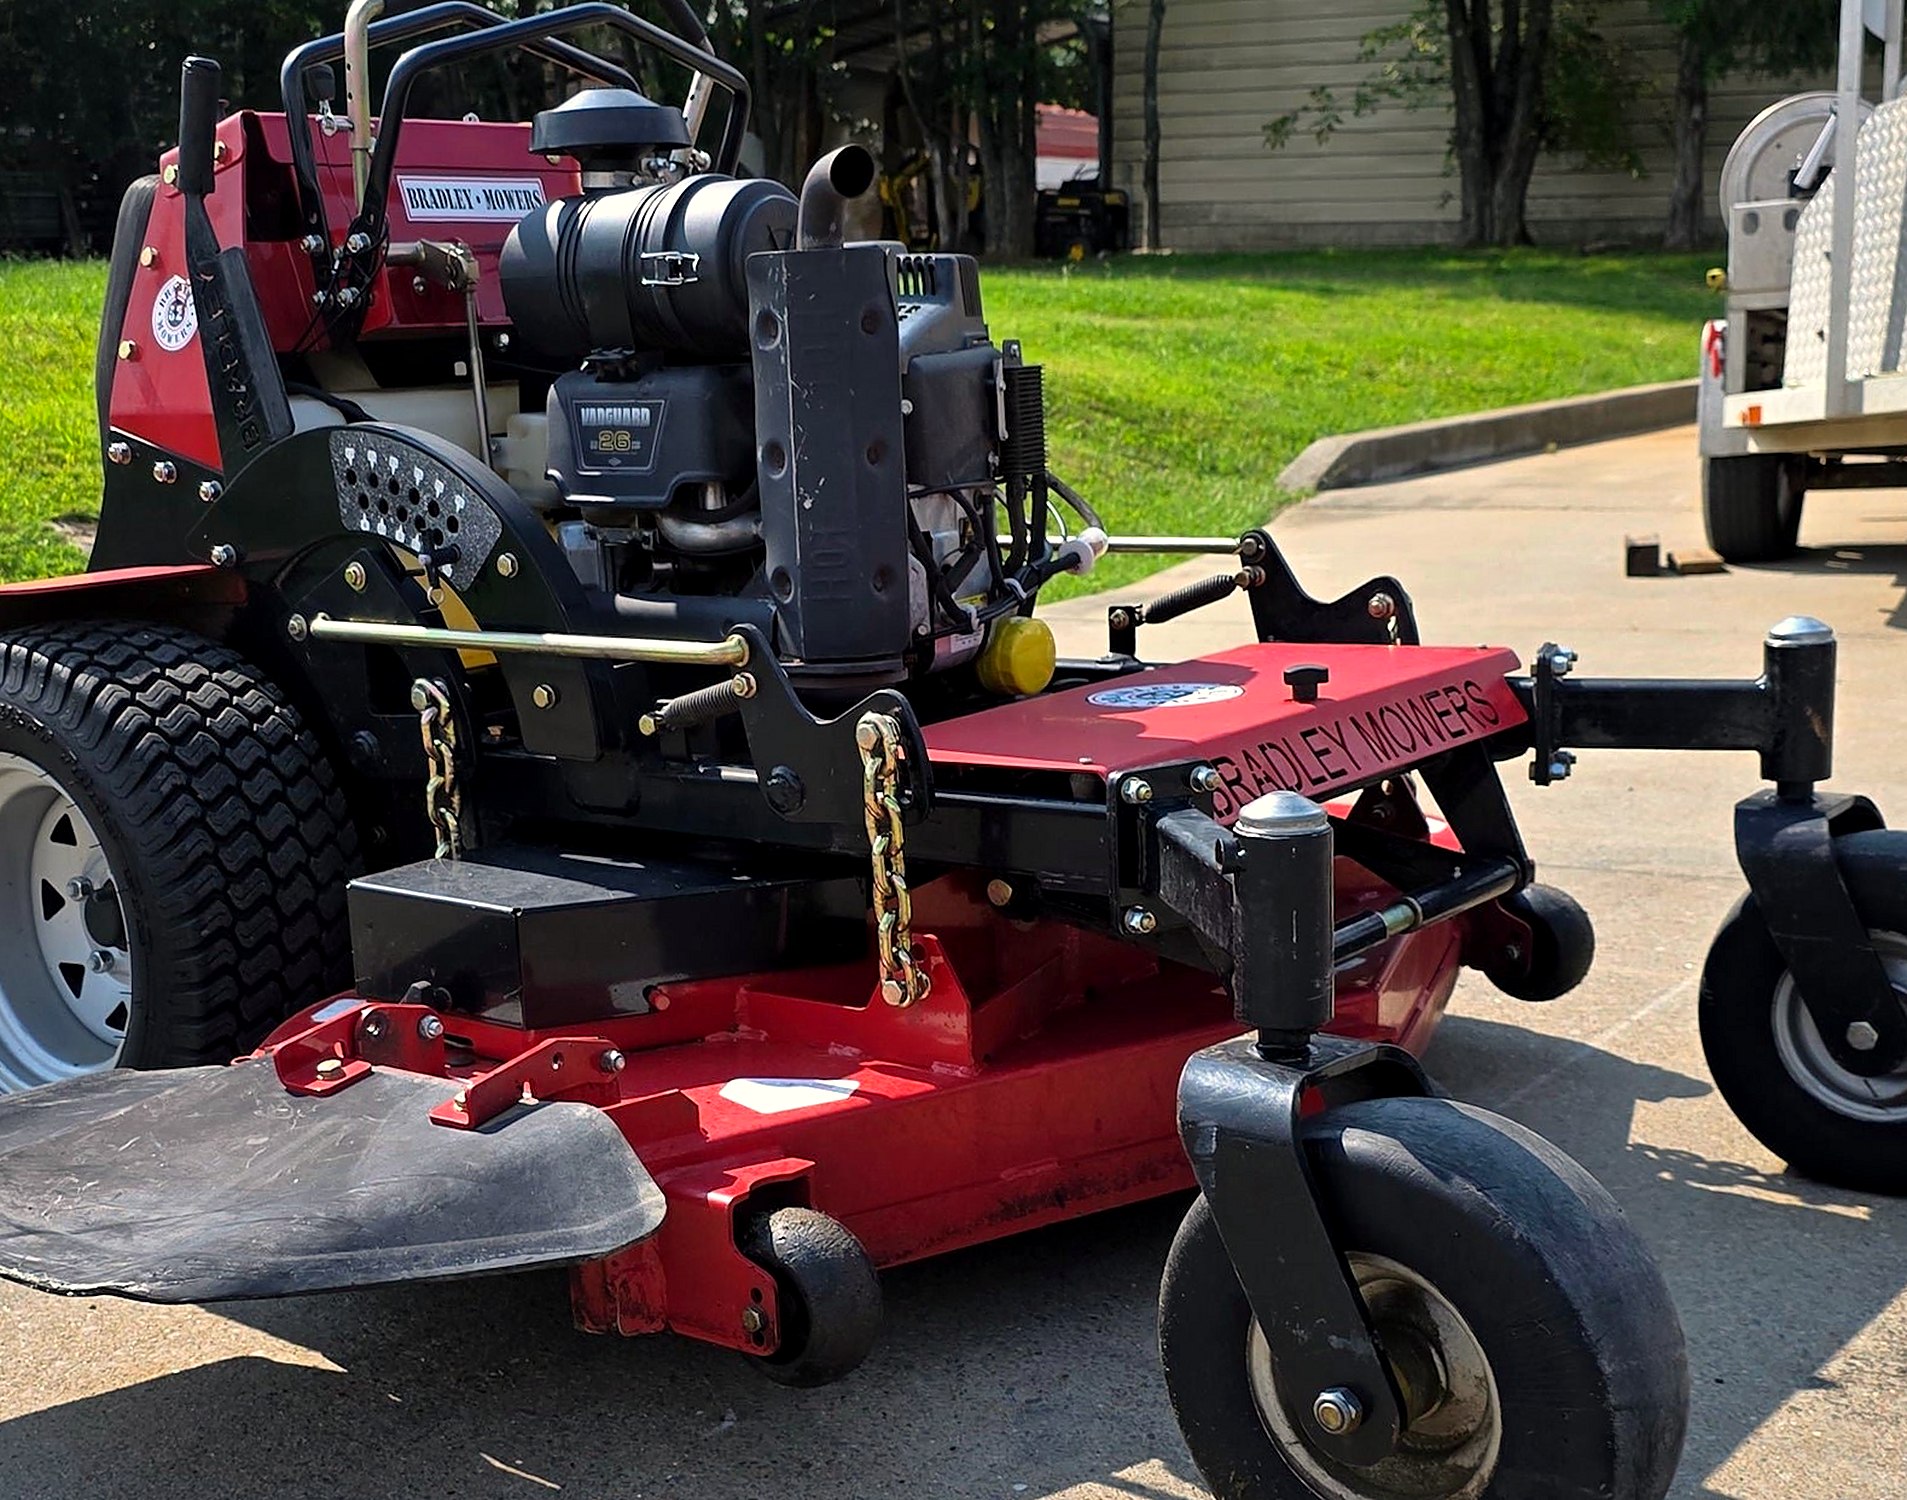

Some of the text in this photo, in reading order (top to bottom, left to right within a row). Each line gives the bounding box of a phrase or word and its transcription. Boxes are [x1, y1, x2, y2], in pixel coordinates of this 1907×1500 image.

[406, 187, 543, 211] BRADLEY MOWERS
[195, 271, 262, 453] BRADLEY
[581, 407, 651, 427] VANGUARD
[598, 430, 631, 451] 26
[1350, 680, 1501, 763] MOWERS
